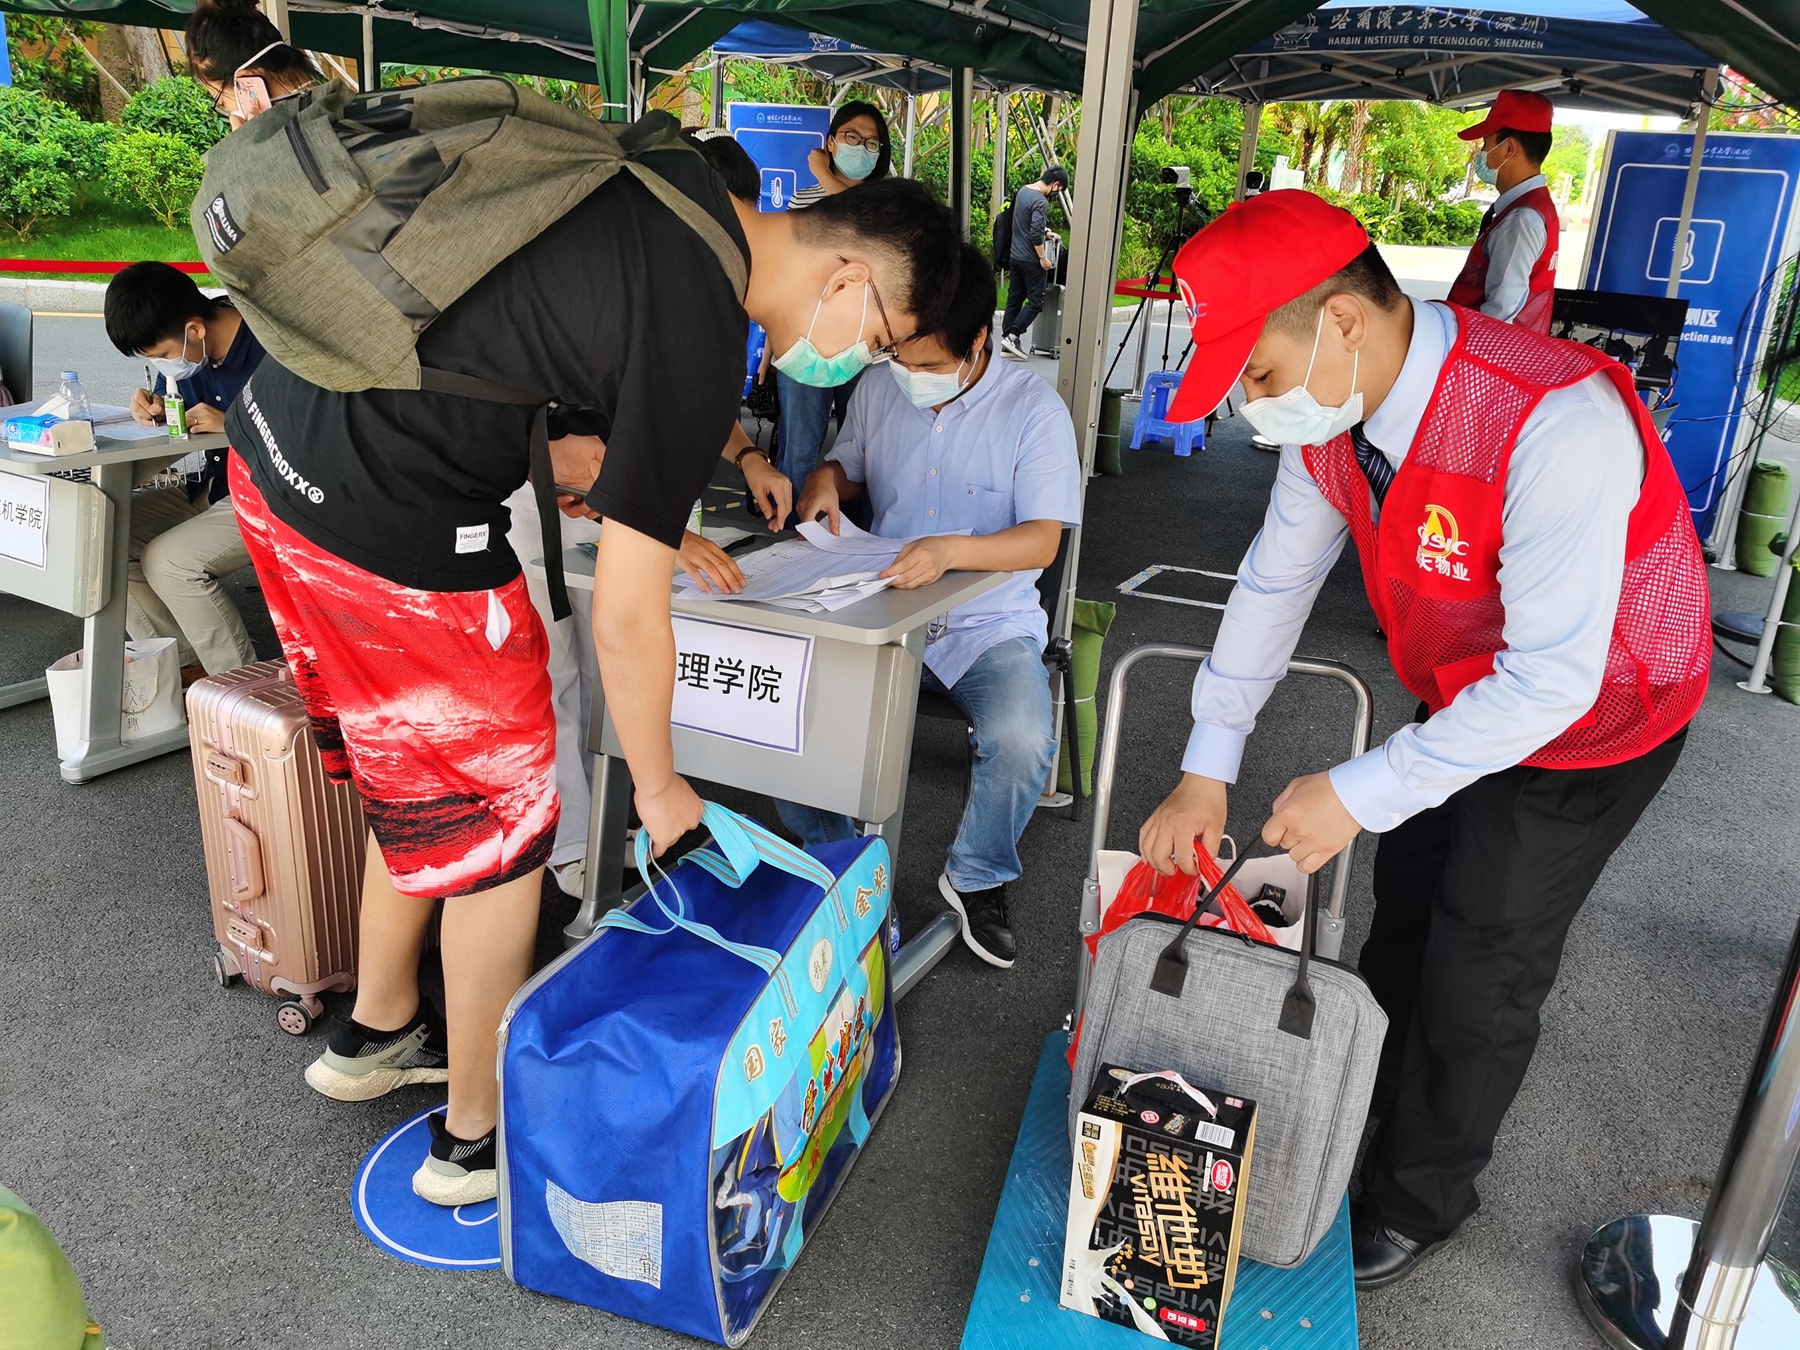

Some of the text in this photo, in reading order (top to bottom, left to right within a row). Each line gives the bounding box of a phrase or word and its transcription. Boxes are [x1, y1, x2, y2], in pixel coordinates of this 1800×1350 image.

[1327, 35, 1361, 46] HARBIN
[1364, 34, 1410, 45] INSTITUTE
[1412, 35, 1425, 45] OF
[1494, 38, 1545, 50] SHENZHEN
[1710, 334, 1734, 345] area
[247, 401, 310, 496] FINGERCROXX
[0, 499, 43, 530] 机学院
[677, 651, 783, 704] 理学院
[1145, 1152, 1209, 1290] 維他奶
